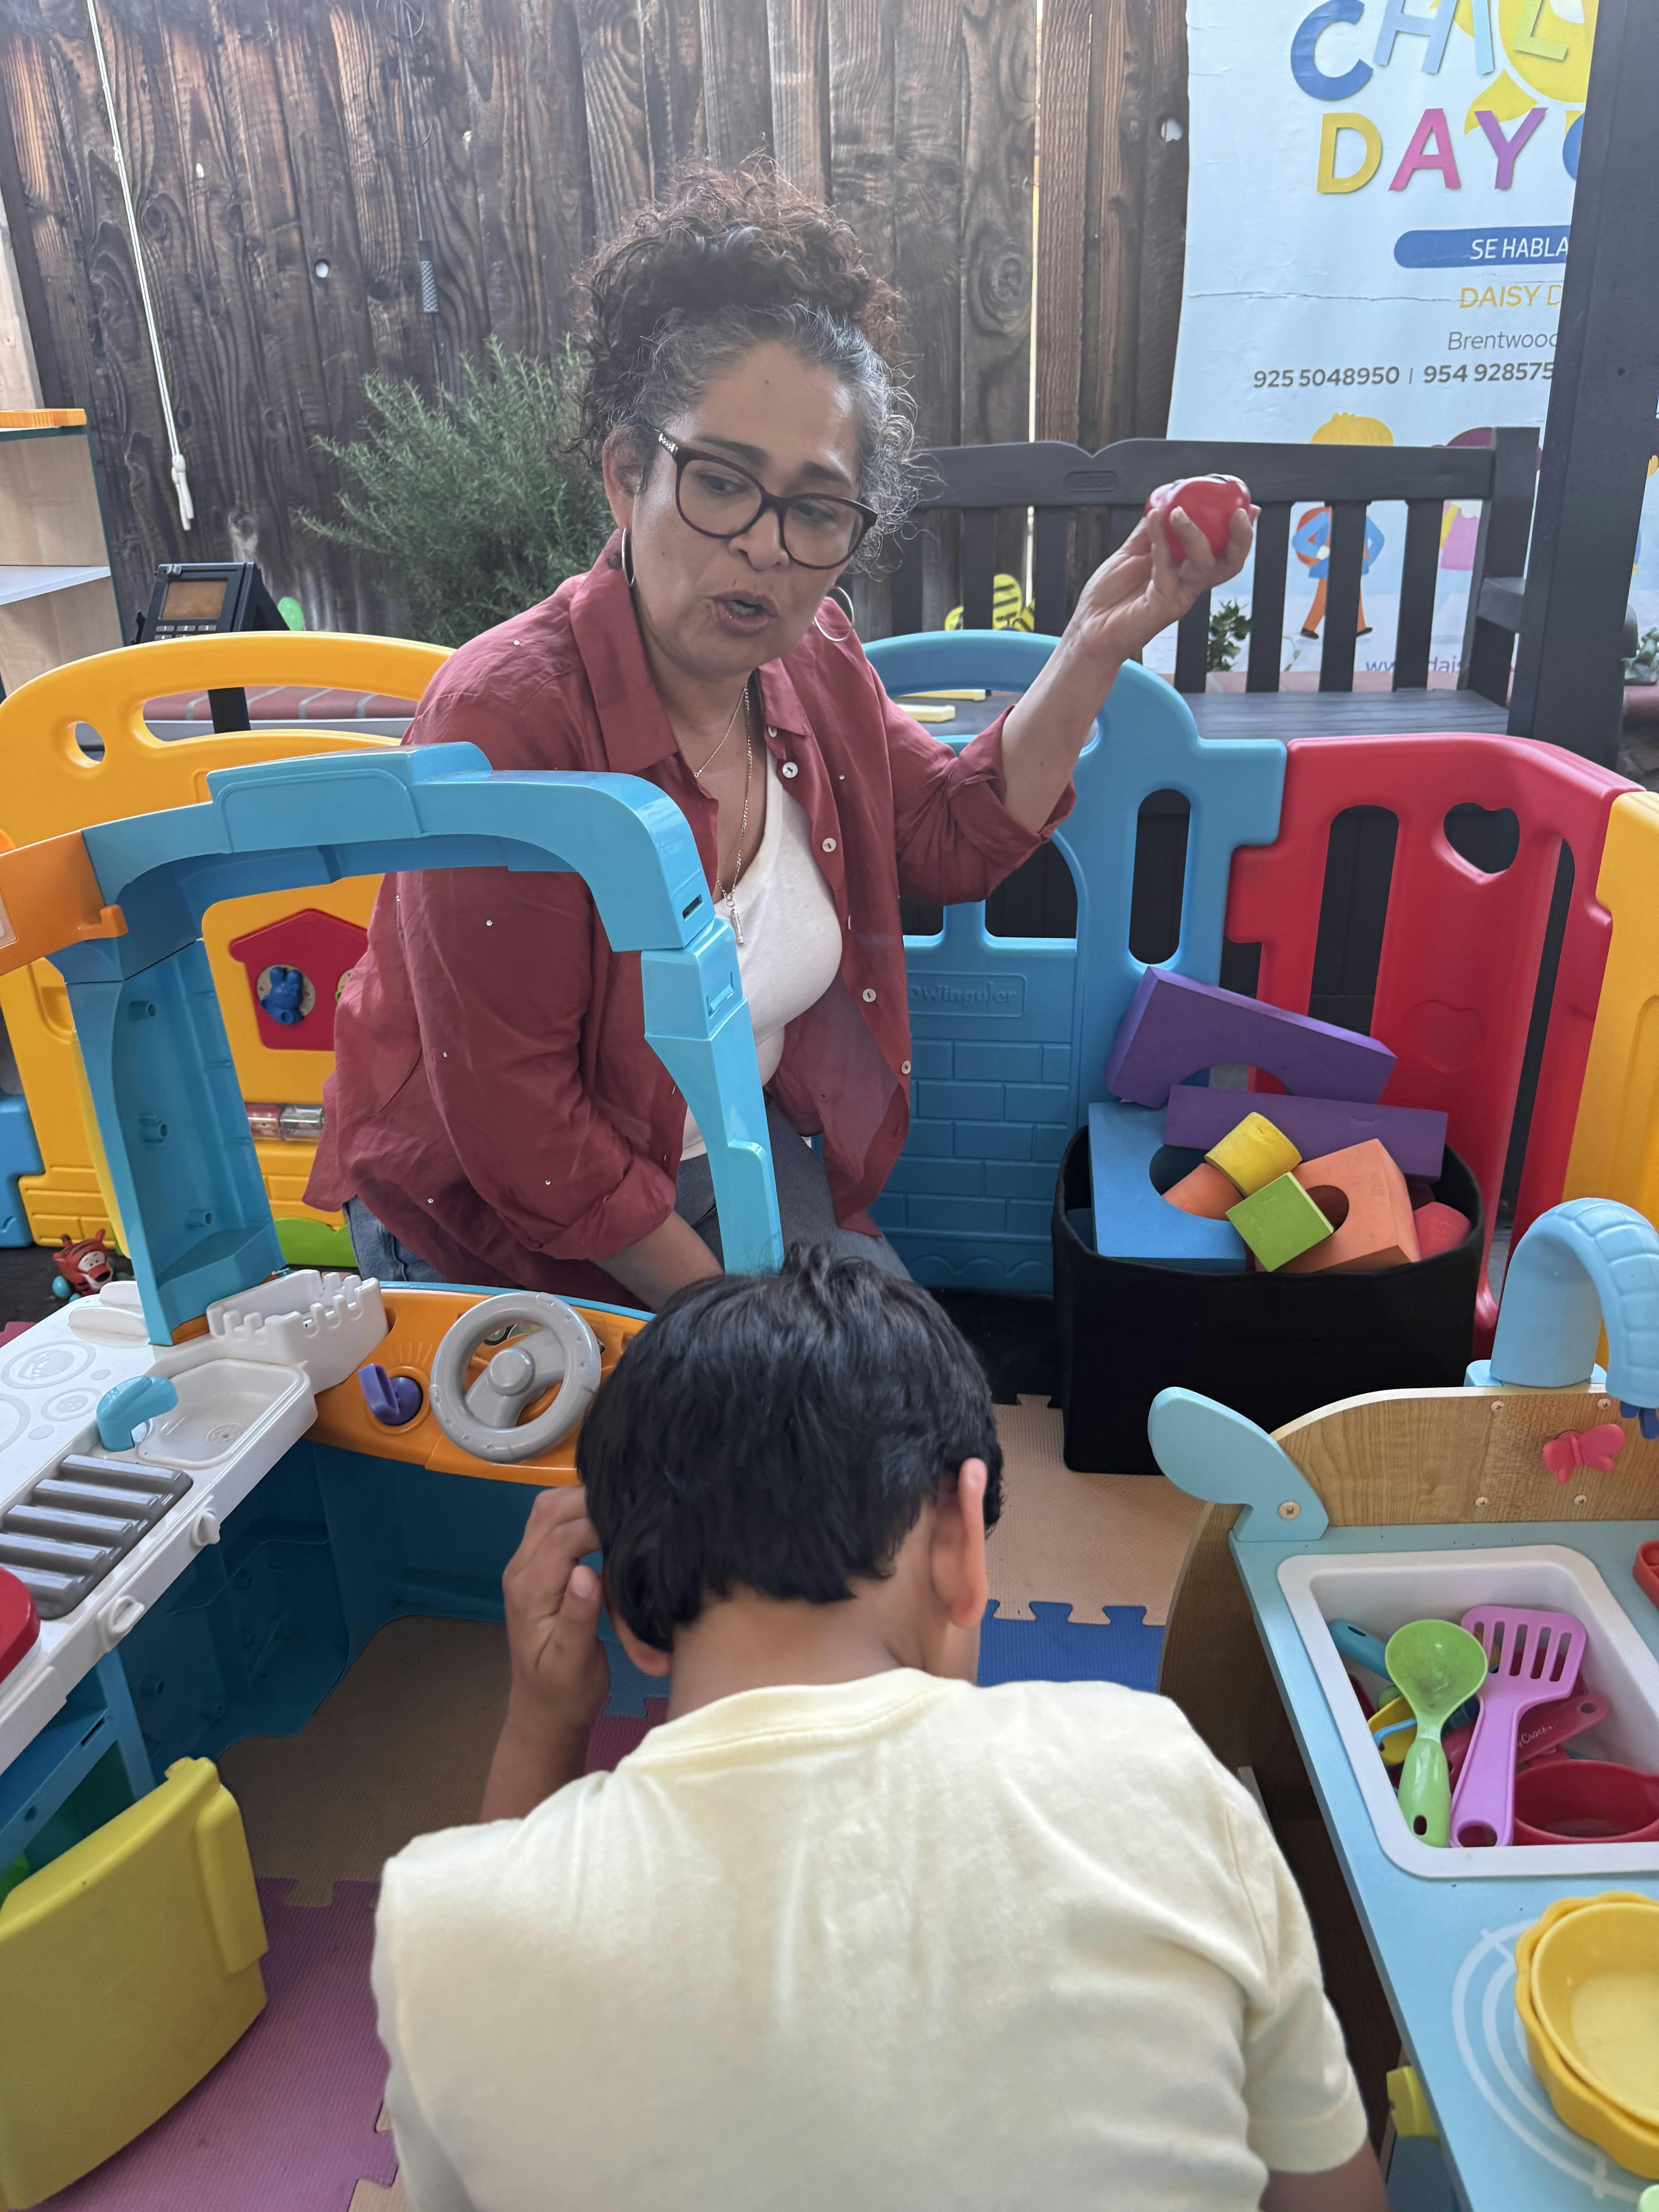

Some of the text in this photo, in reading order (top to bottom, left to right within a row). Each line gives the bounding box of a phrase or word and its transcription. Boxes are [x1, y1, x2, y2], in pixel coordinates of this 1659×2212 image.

[1291, 0, 1568, 101] CHIL
[1317, 107, 1548, 193] DAY
[1470, 236, 1568, 259] SE HABLA
[1459, 285, 1541, 308] DAISY
[1254, 362, 1554, 387] 925 5048950 954 928575
